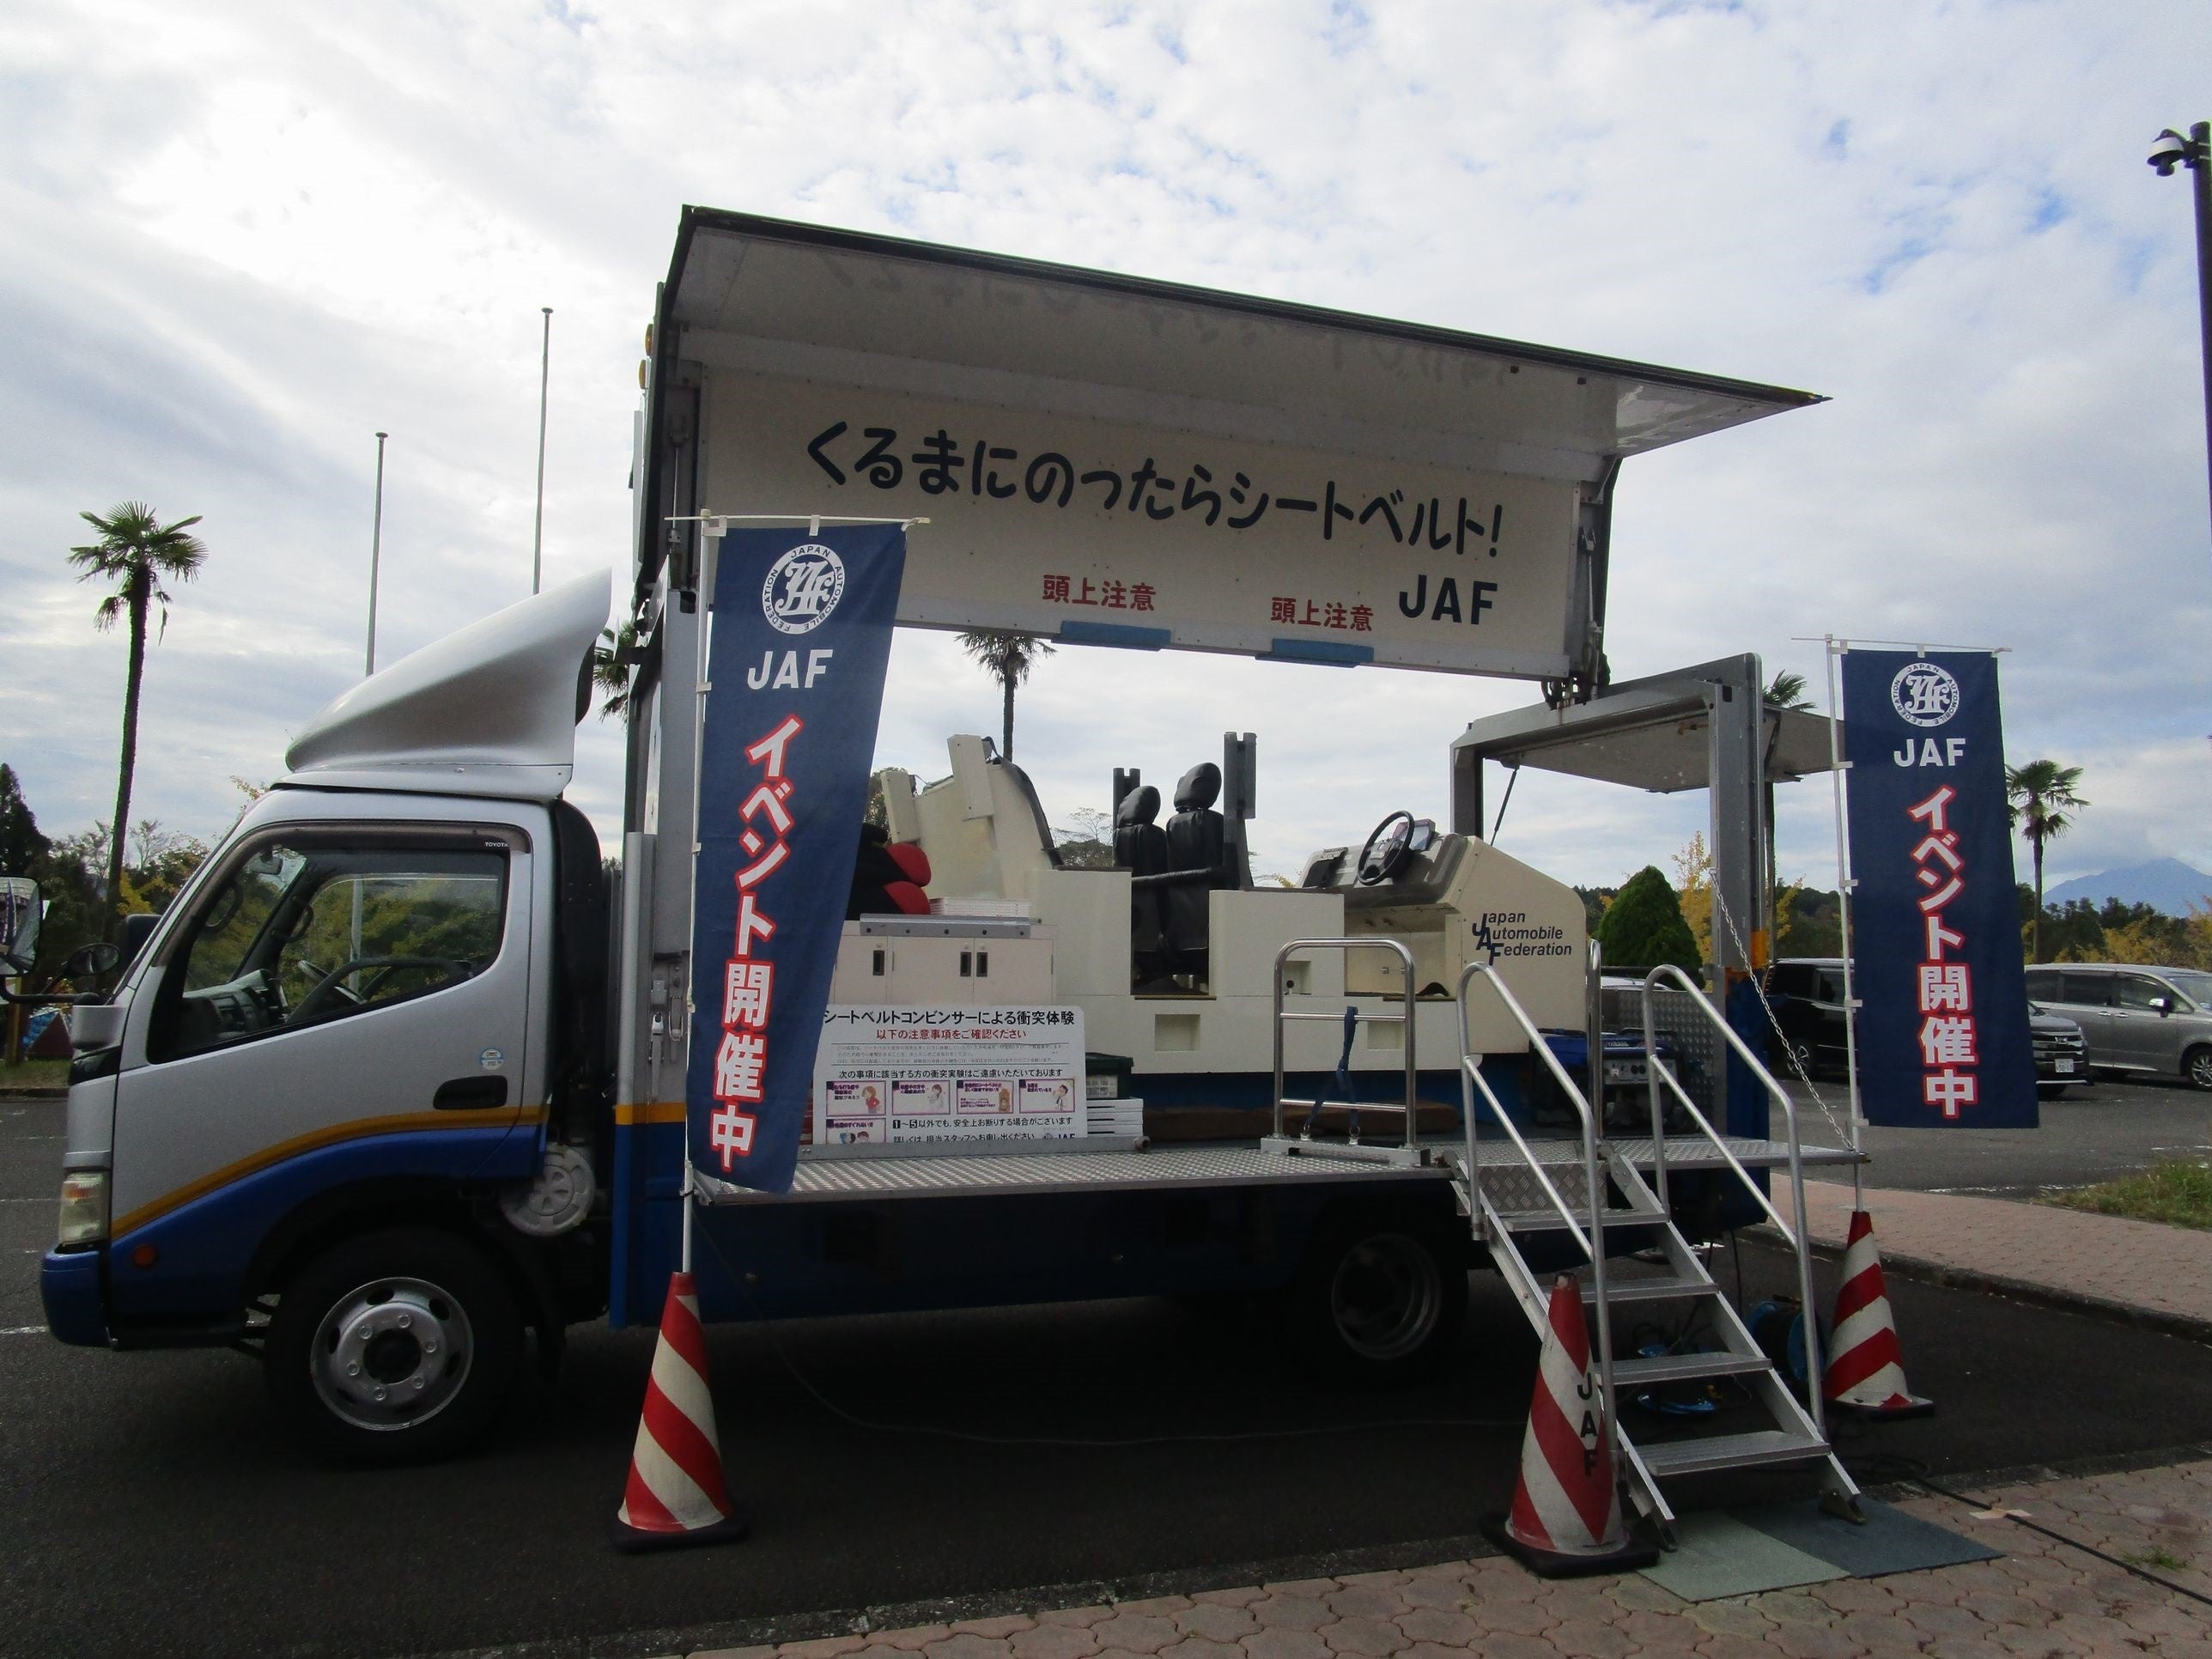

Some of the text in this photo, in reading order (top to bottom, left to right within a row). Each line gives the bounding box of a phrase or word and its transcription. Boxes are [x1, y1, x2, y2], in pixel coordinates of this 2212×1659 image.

[807, 421, 1503, 557] くるまにのったらシートベルト!
[763, 544, 844, 632] JAPAN AUTOMOBILE FEDERATION
[1042, 573, 1157, 611] 頭上注意
[1399, 574, 1498, 625] JAF
[1270, 596, 1374, 632] 頭上注意
[747, 648, 834, 690] JAF
[1892, 663, 1960, 726] JAPAN AUTOMOBILE FEDERATION
[1893, 738, 1966, 768] JAF
[711, 713, 803, 1174] イベント開催中
[1472, 912, 1526, 937] Japan
[1475, 926, 1564, 951] Automobile
[1488, 942, 1572, 967] Federation
[1908, 784, 1978, 1121] イベント開催中
[823, 1010, 1075, 1026] シートベルトコンビンサーによる衝突体験
[876, 1029, 1027, 1041] 以下の注意事項をご確認ください
[1577, 1372, 1598, 1477] JAF
